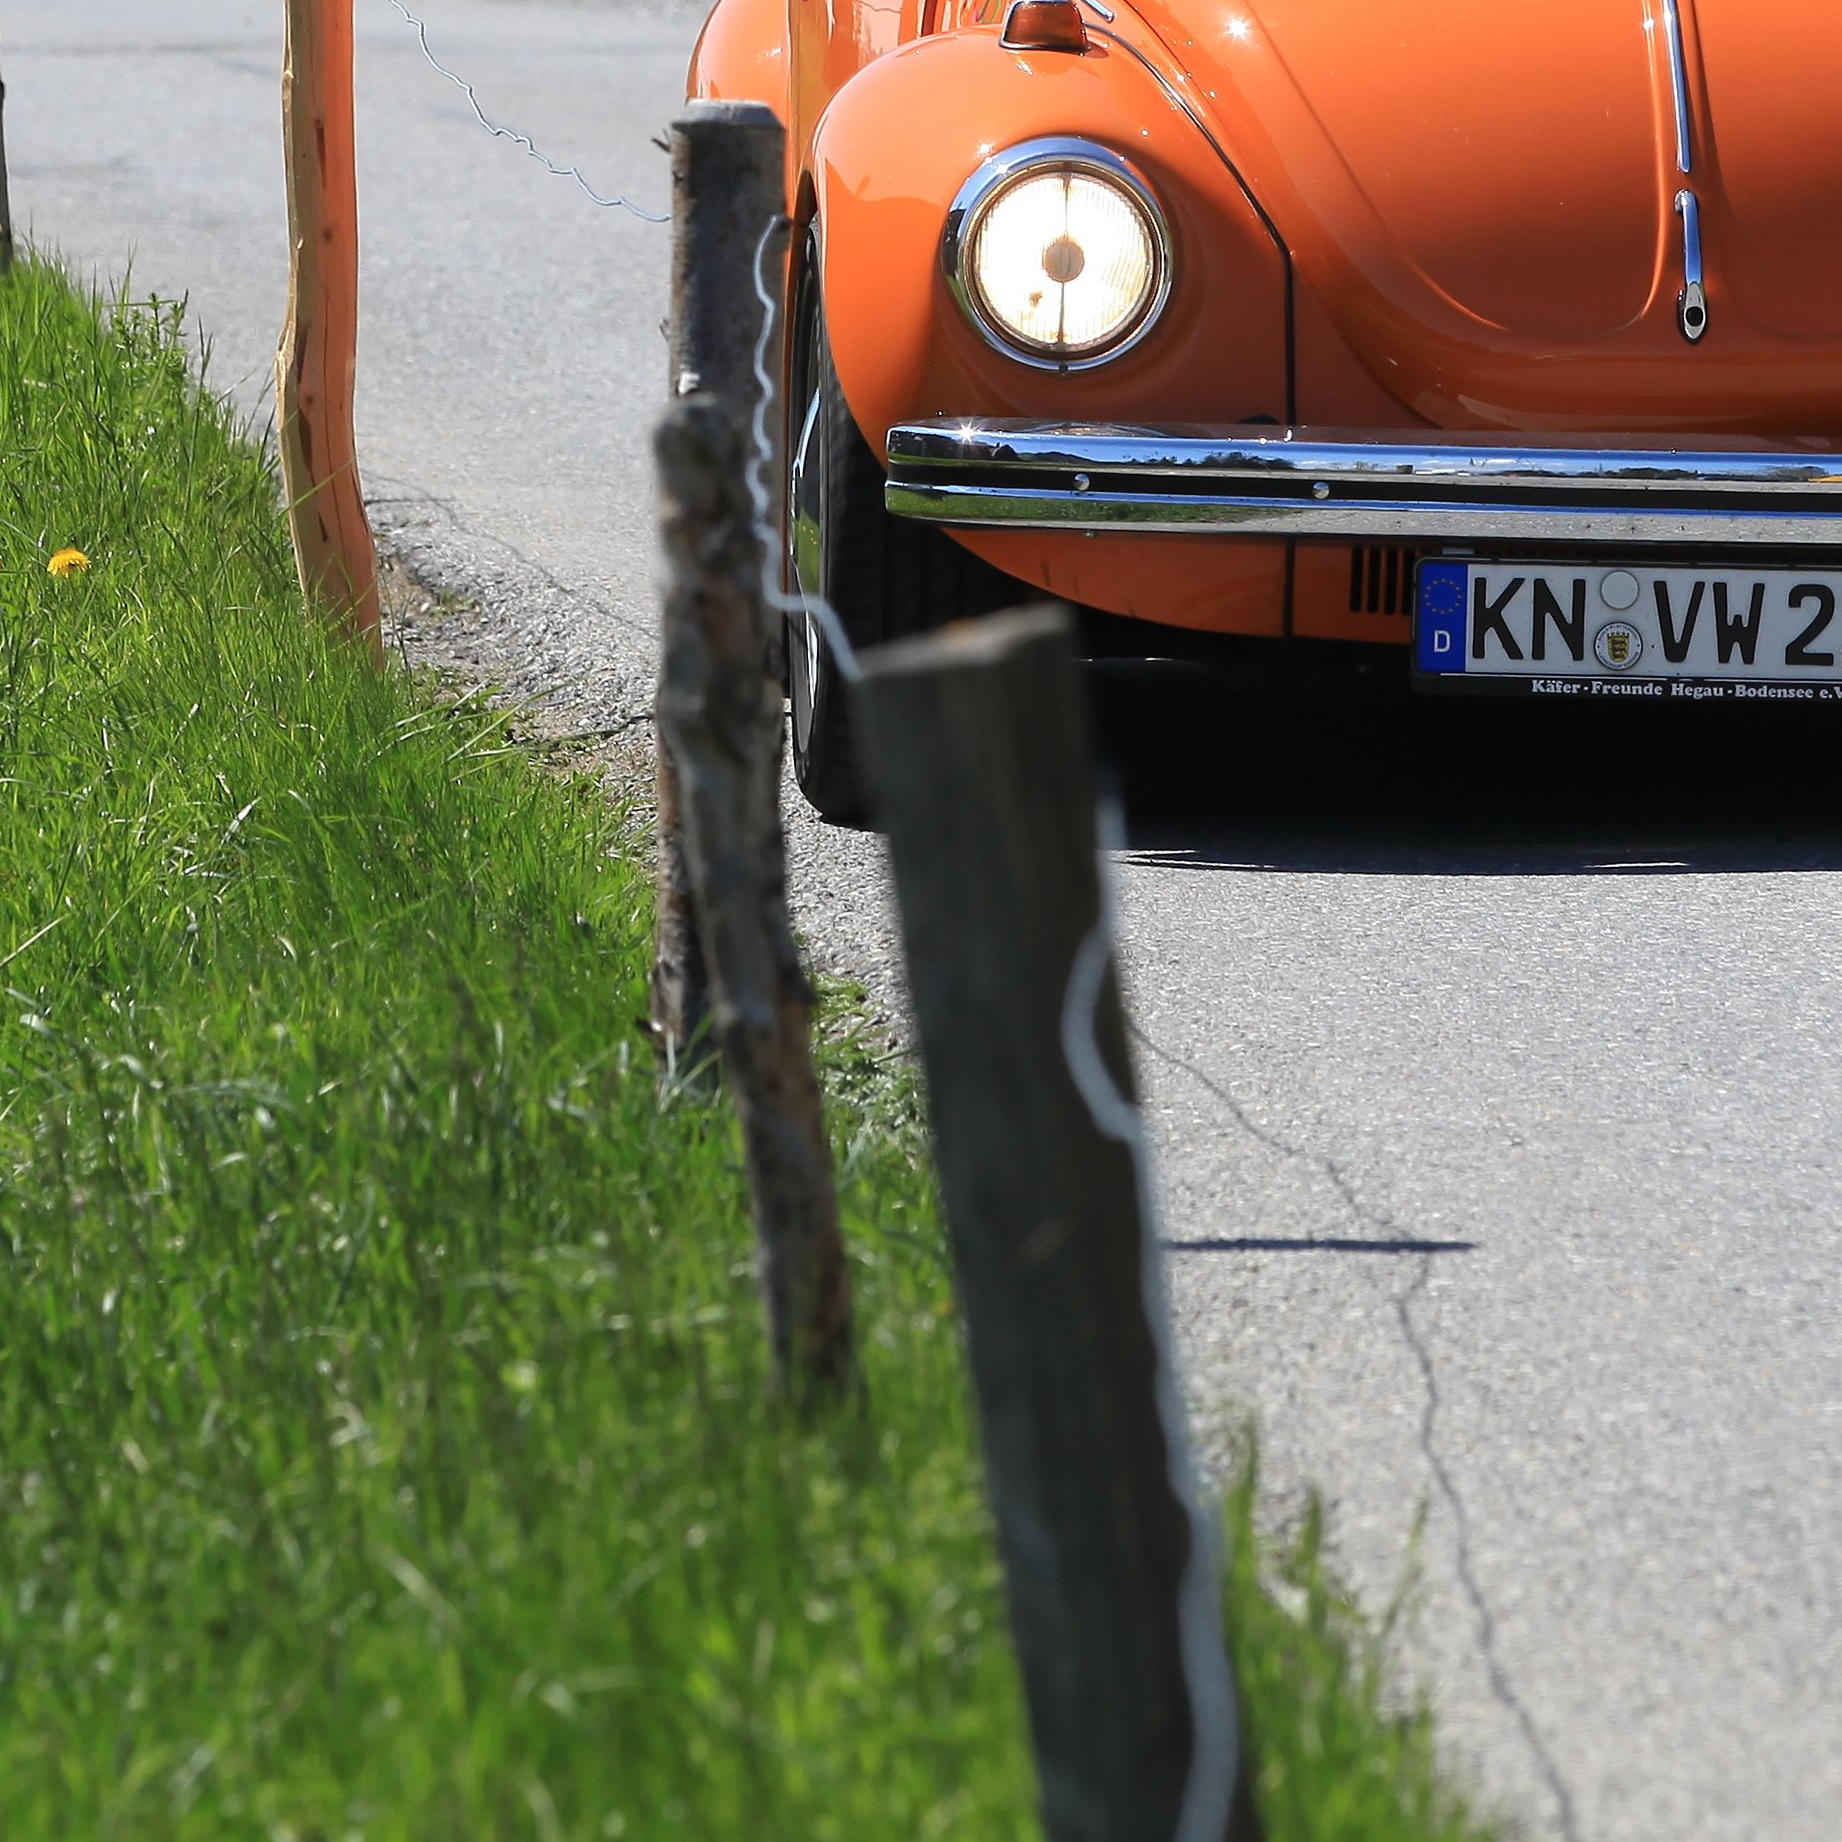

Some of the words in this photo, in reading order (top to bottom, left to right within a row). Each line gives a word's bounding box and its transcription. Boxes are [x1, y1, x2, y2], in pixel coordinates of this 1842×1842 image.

[1433, 631, 1451, 653] D
[1472, 576, 1586, 661] KN
[1653, 581, 1766, 666] VW
